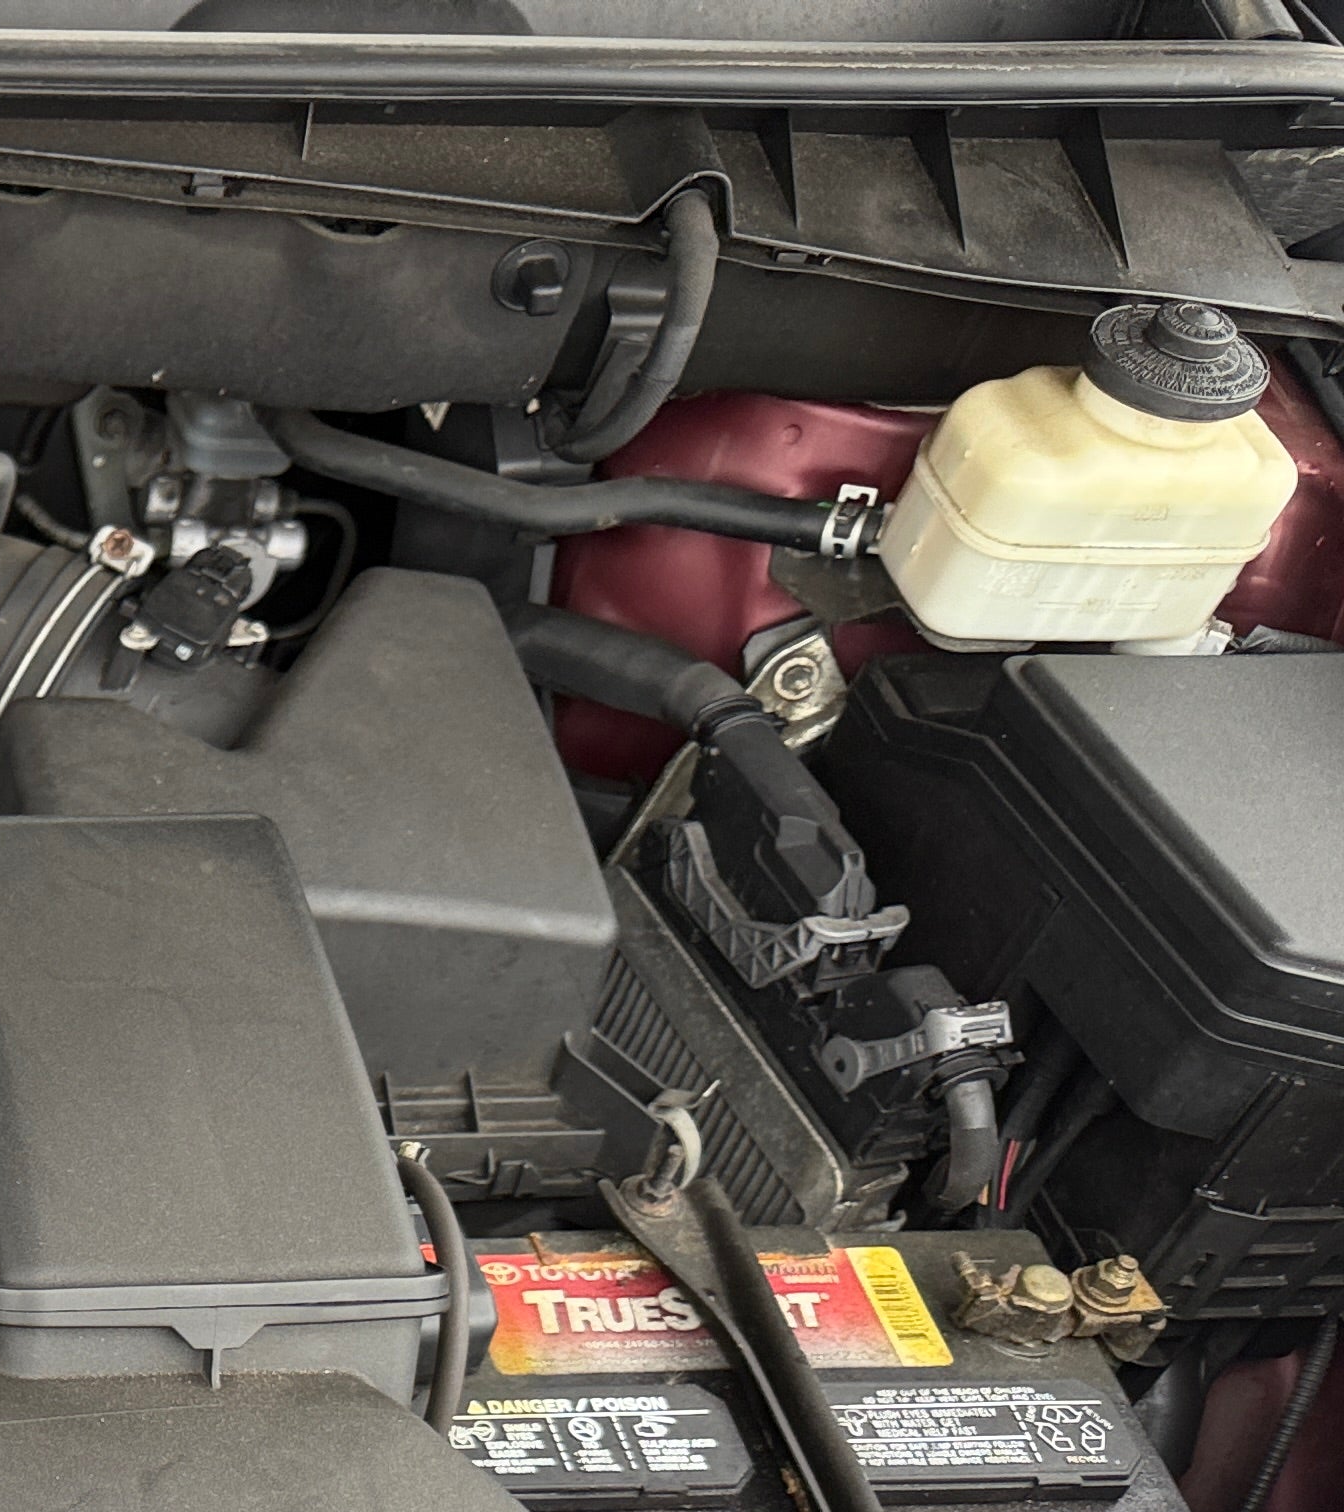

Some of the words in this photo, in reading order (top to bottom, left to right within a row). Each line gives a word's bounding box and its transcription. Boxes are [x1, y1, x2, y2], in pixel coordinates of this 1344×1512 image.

[486, 1399, 573, 1414] DANGER
[589, 1396, 670, 1411] POISON
[1065, 1455, 1109, 1463] RECYCLE
